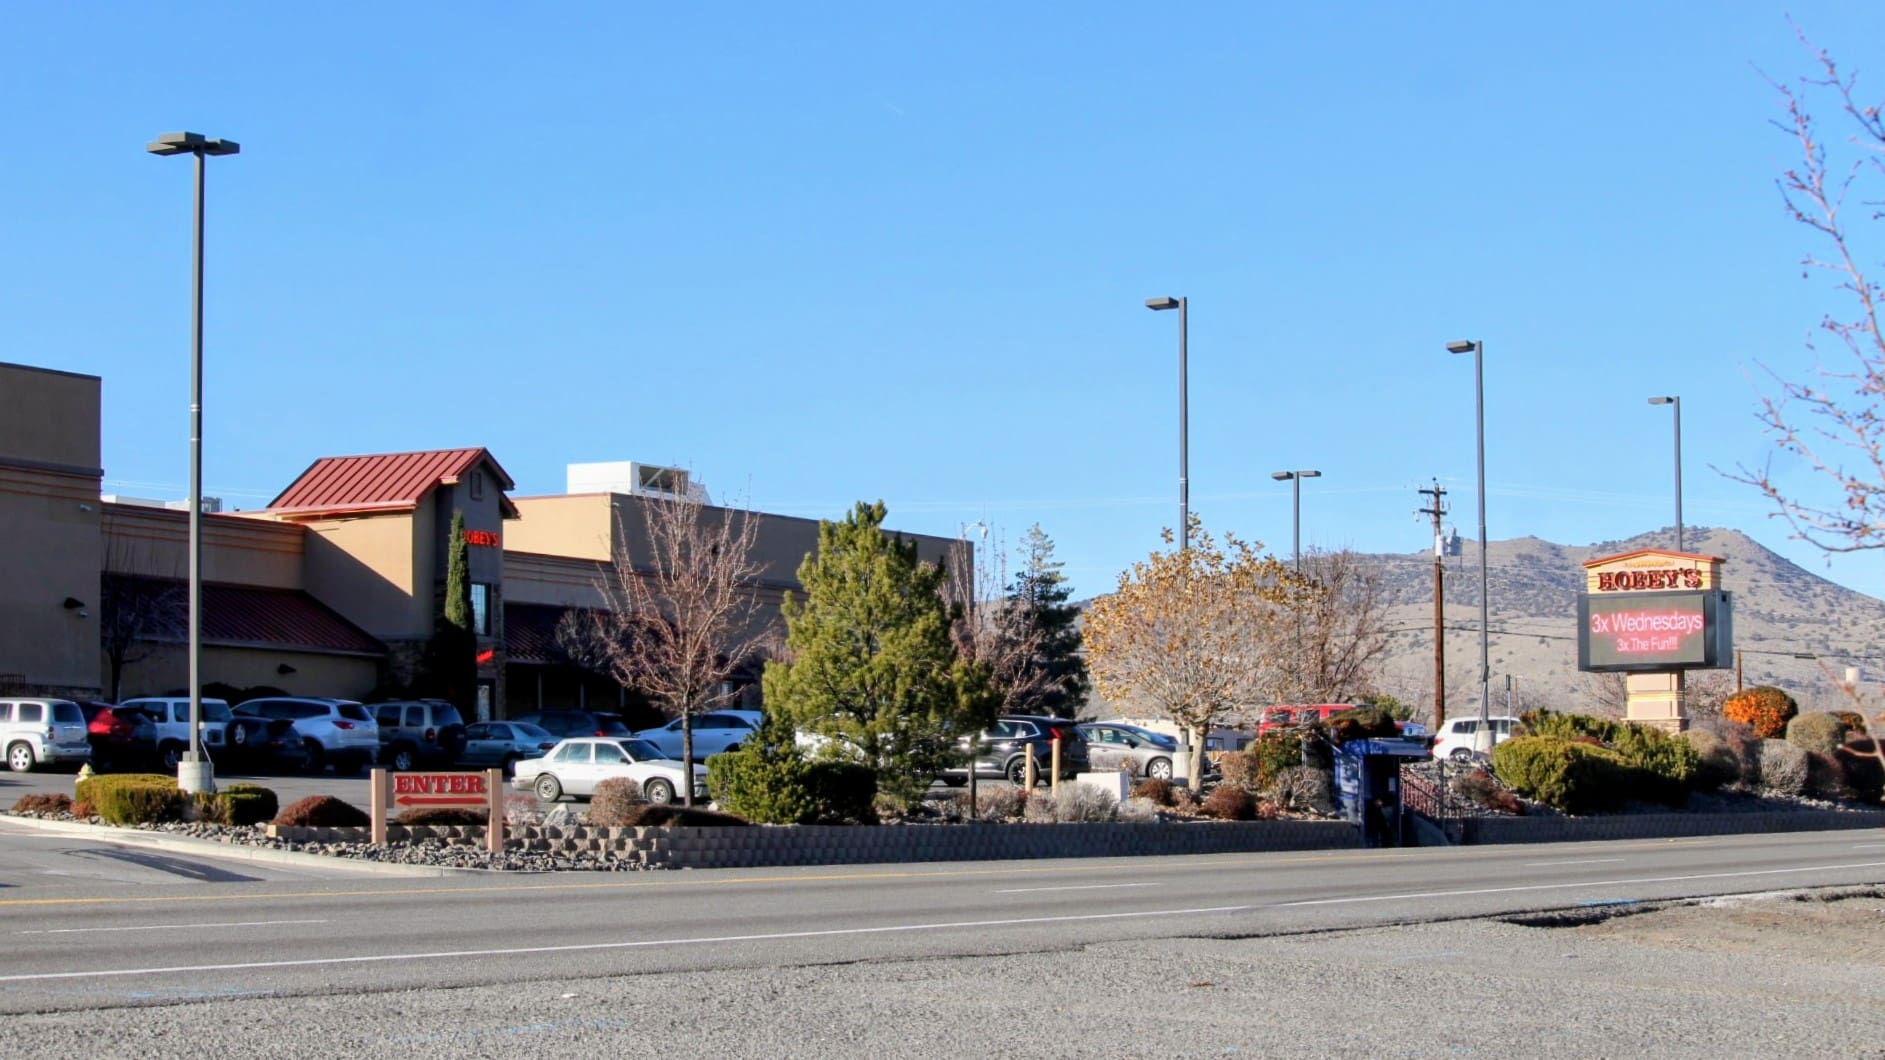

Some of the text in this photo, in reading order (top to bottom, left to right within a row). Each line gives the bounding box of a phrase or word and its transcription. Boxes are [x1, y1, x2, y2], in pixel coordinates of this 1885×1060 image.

[463, 530, 499, 547] OBEY'S
[1597, 567, 1703, 591] HOBEY'S
[1592, 611, 1703, 634] 3x Wednesdays
[1617, 638, 1629, 652] 3x
[1630, 637, 1649, 651] The
[393, 775, 487, 794] ENTER
